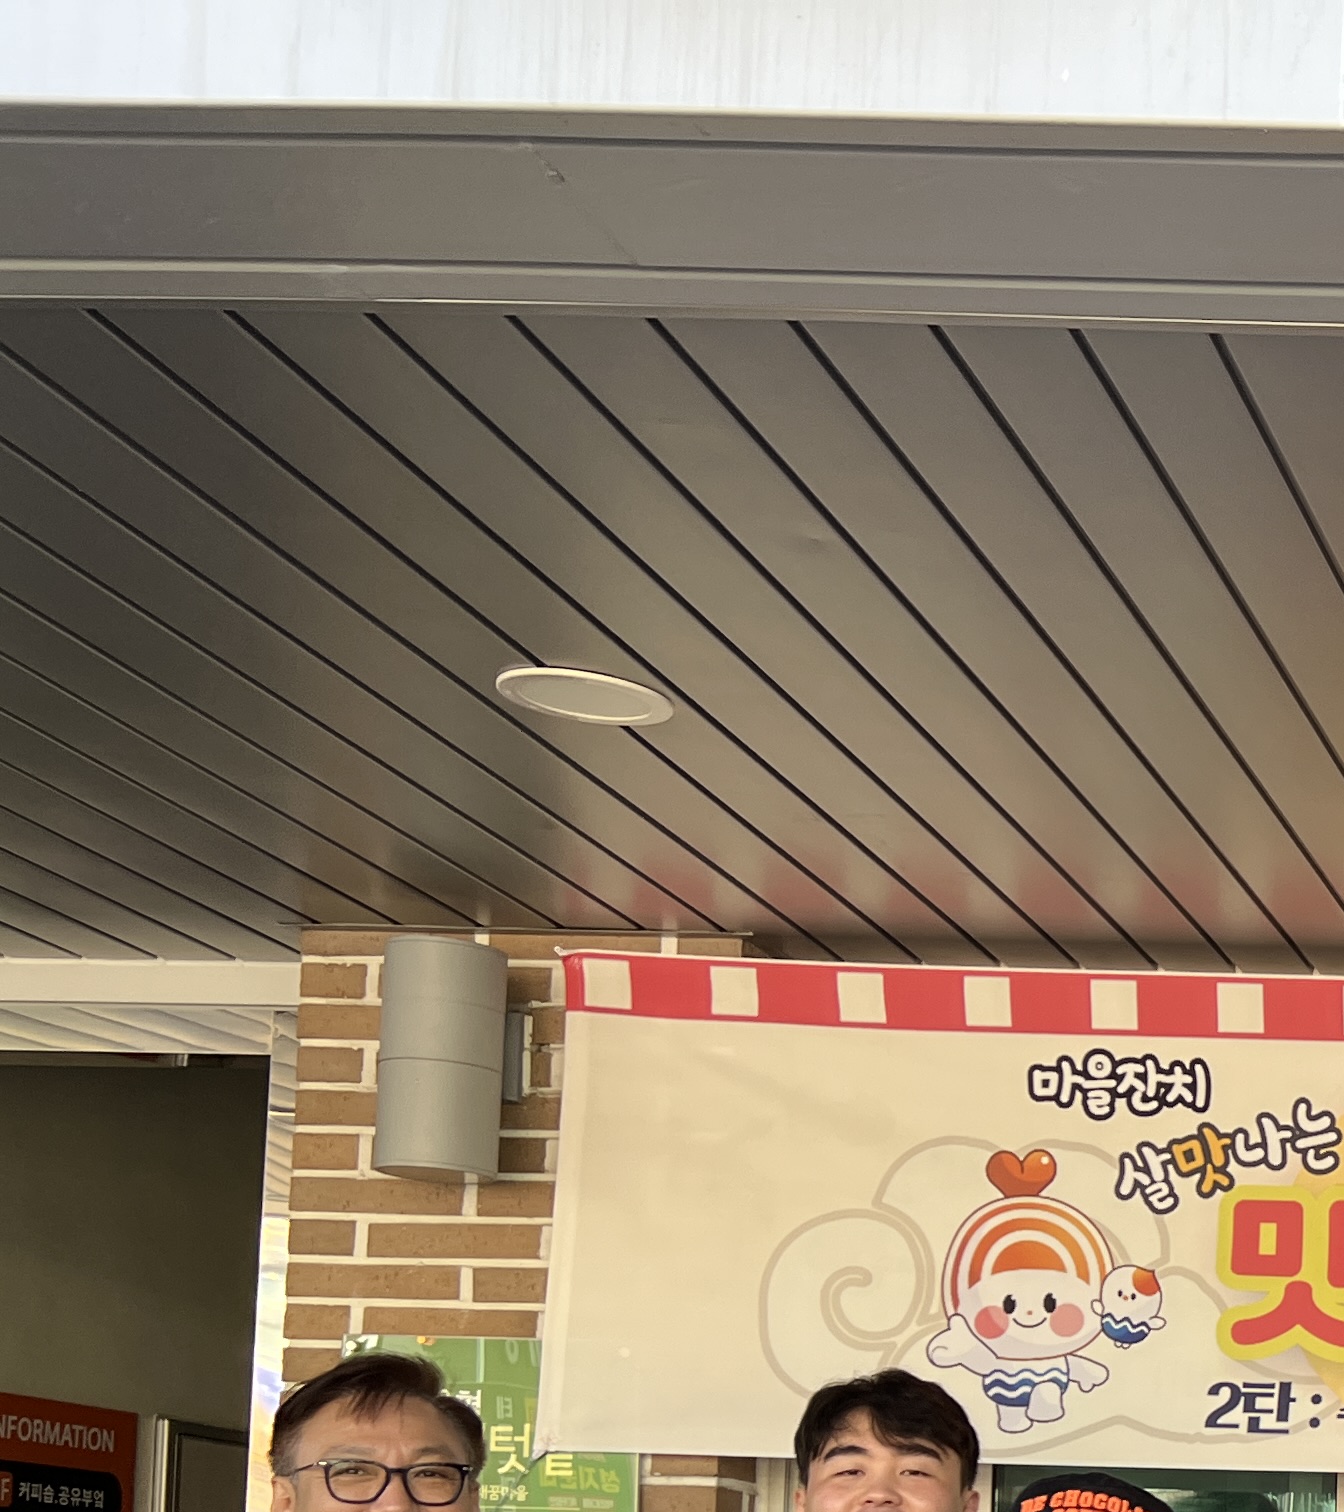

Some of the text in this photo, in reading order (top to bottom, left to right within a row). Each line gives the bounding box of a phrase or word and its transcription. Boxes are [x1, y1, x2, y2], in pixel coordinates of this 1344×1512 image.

[1028, 1048, 1211, 1120] 마을잔치
[1115, 1099, 1341, 1215] 살맛나는
[0, 1414, 116, 1453] NFORMATION
[1205, 1381, 1297, 1436] 2탄
